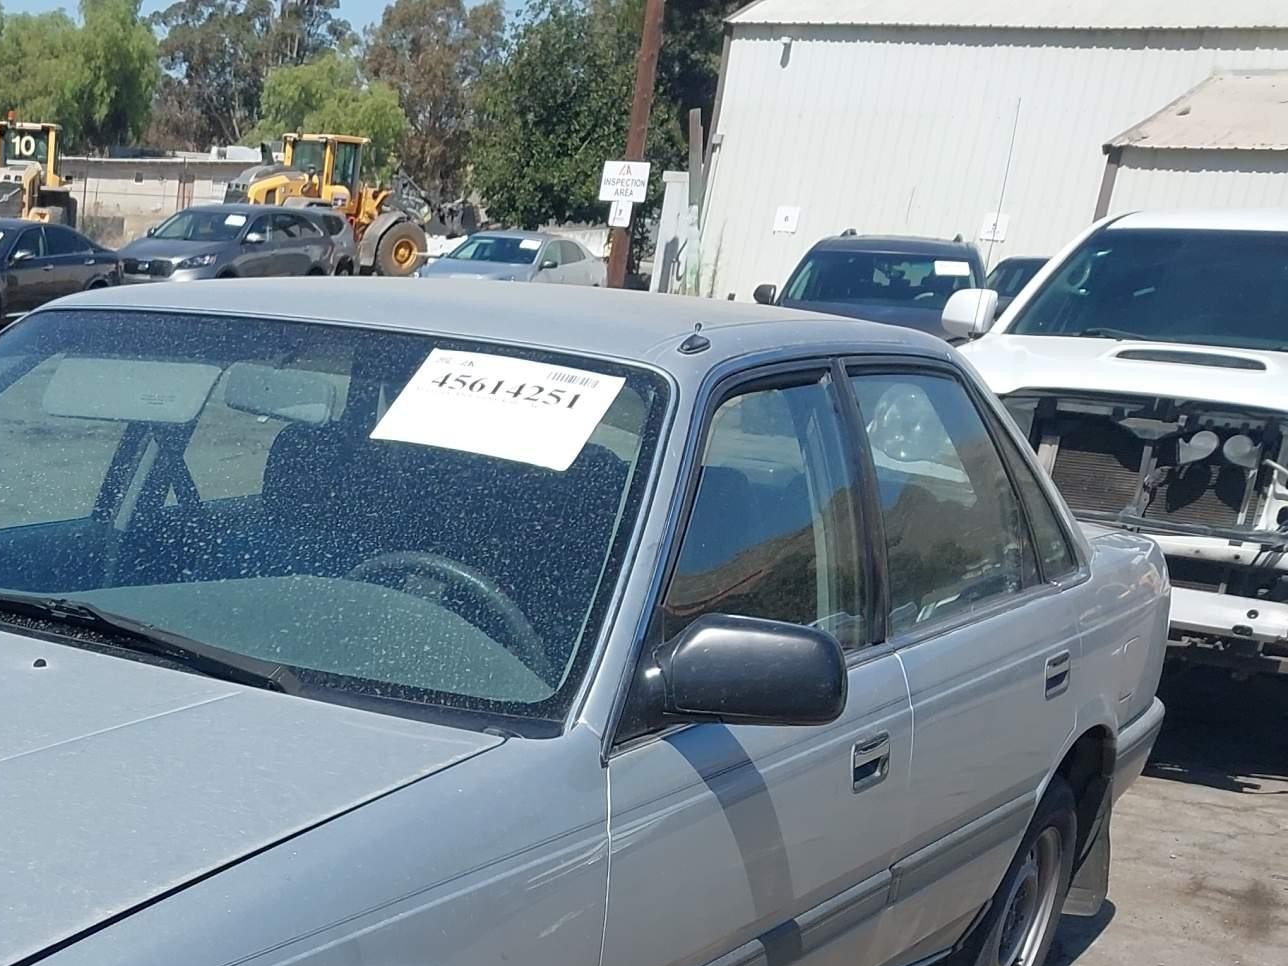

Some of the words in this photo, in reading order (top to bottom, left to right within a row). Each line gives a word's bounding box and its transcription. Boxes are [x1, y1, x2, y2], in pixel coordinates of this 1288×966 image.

[12, 136, 35, 156] 10
[603, 177, 646, 188] INSPECTION
[614, 188, 633, 197] AREA
[431, 372, 582, 410] 45614251
